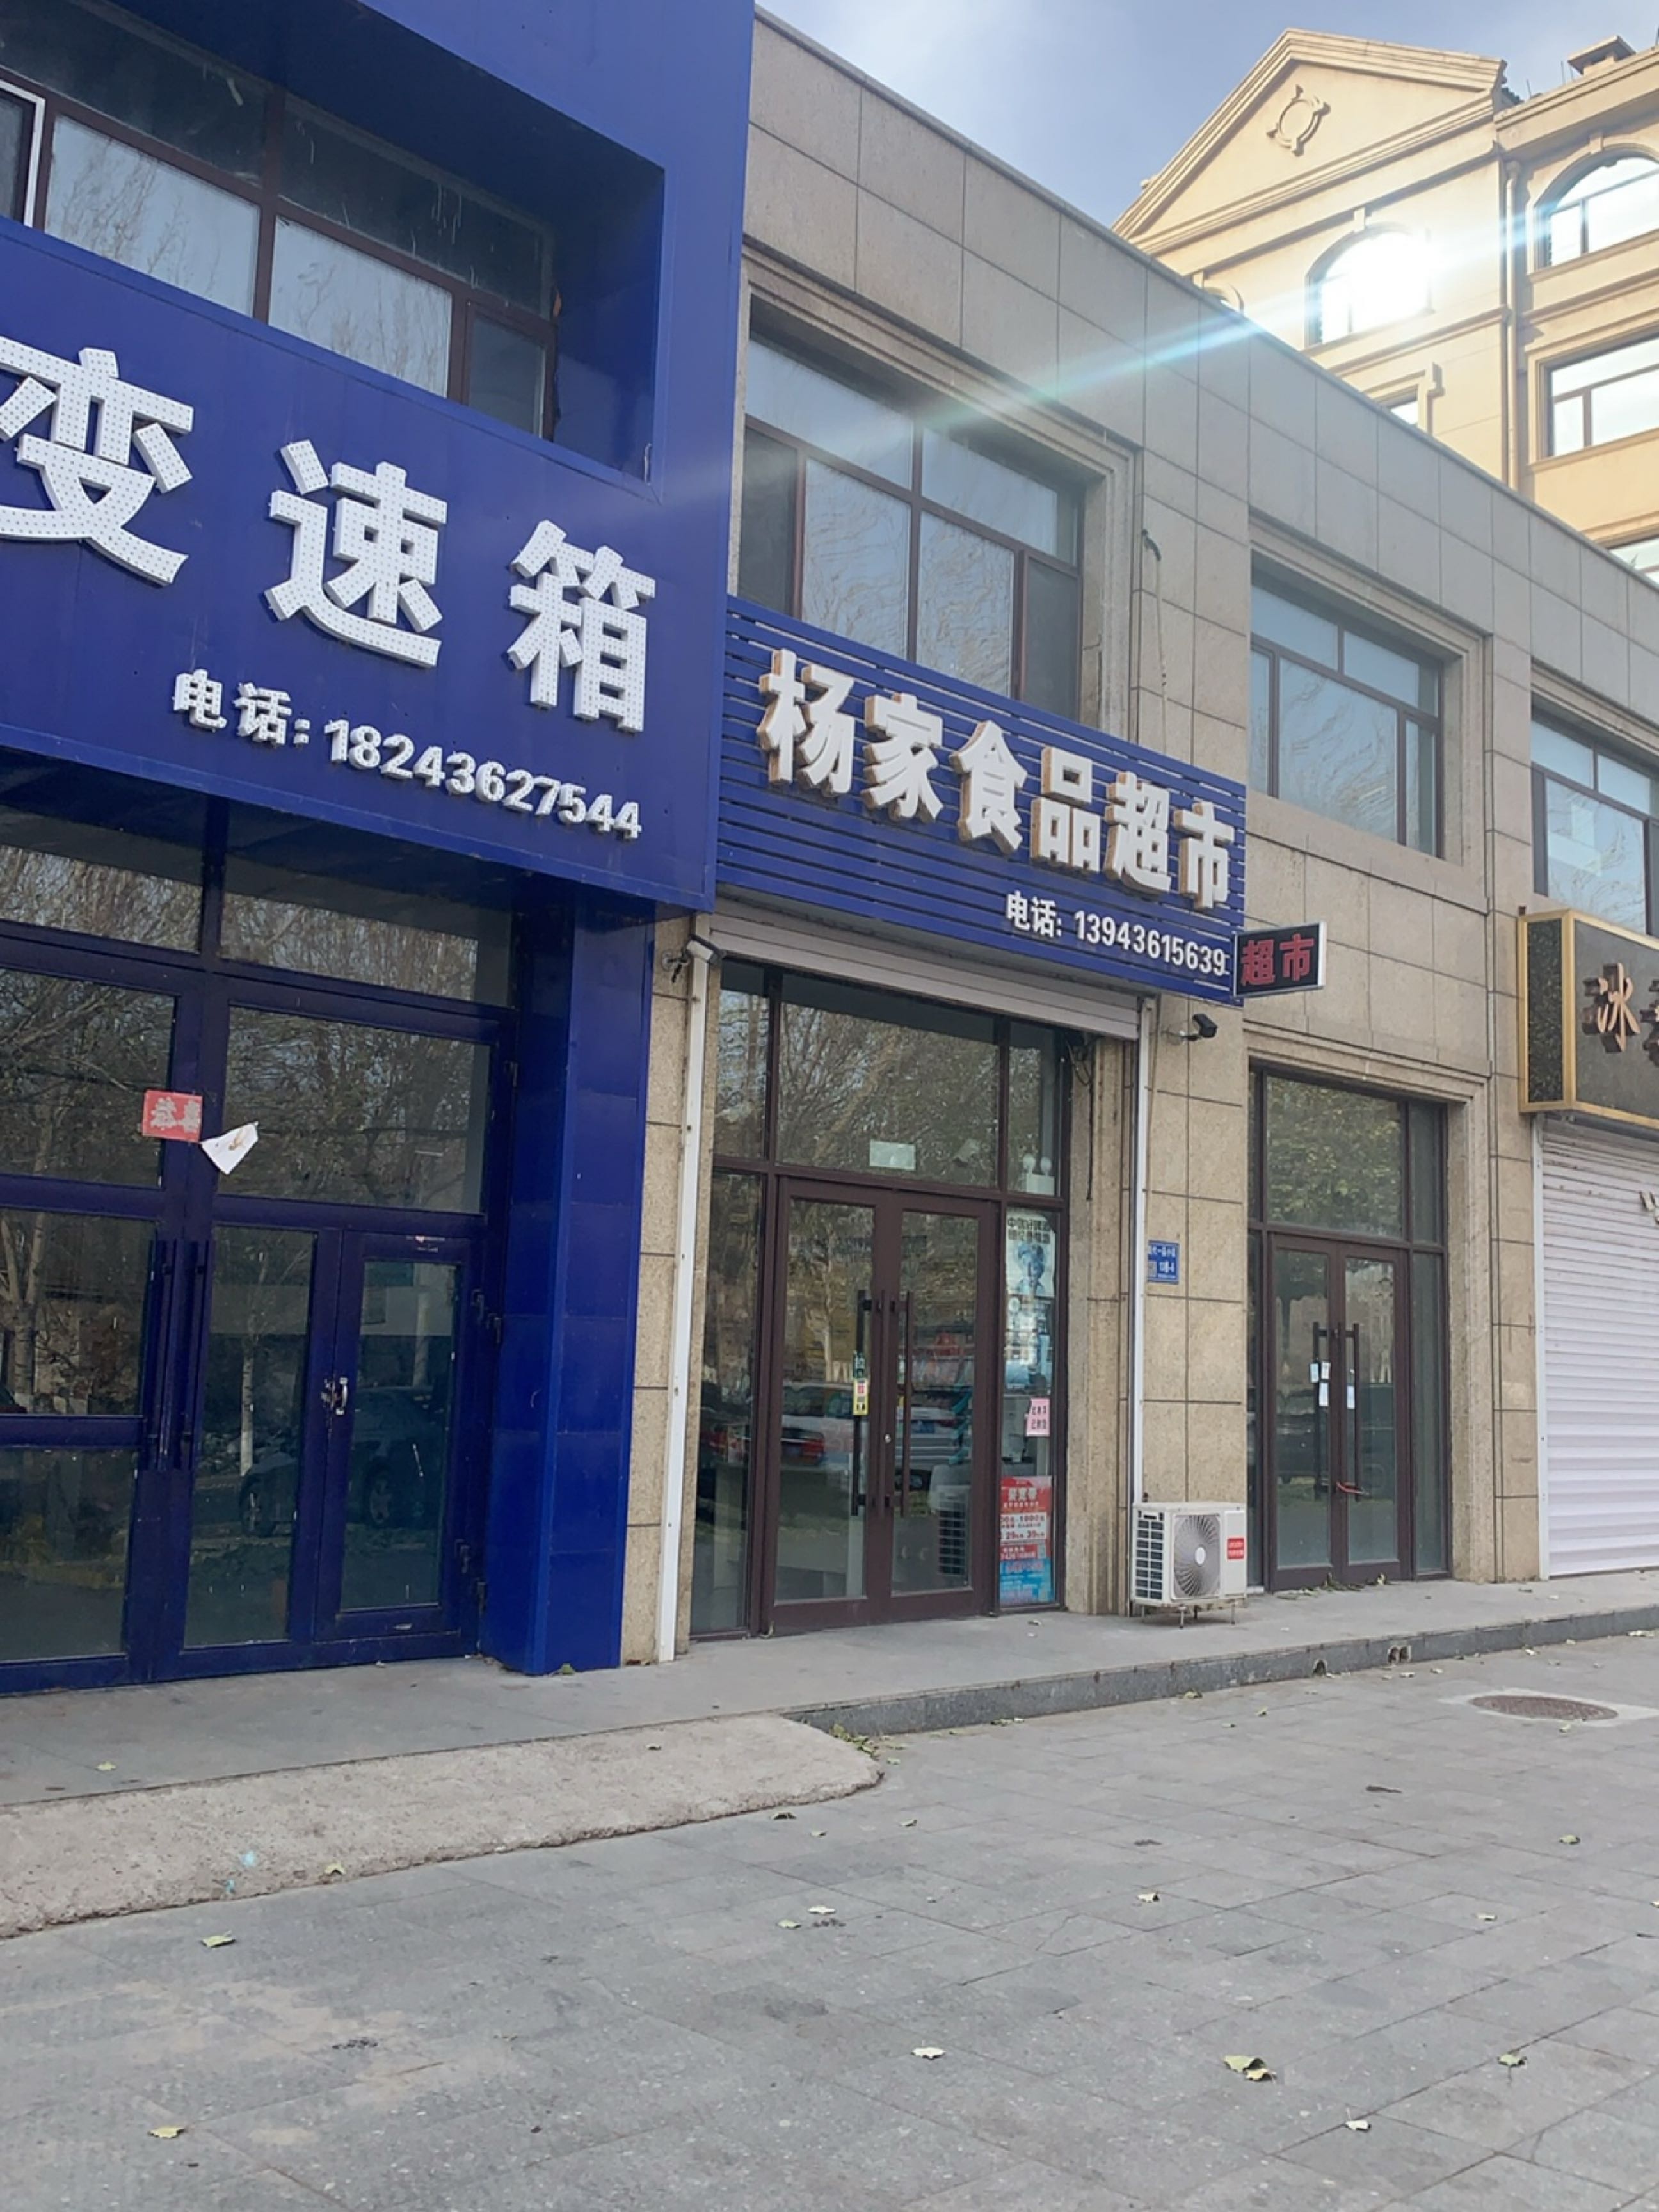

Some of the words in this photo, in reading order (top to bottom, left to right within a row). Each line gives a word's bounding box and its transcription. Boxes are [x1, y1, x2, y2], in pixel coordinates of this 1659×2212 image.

[0, 337, 656, 733] 变速箱
[758, 648, 1235, 910] 杨家食品超市
[1240, 933, 1315, 986] 超市
